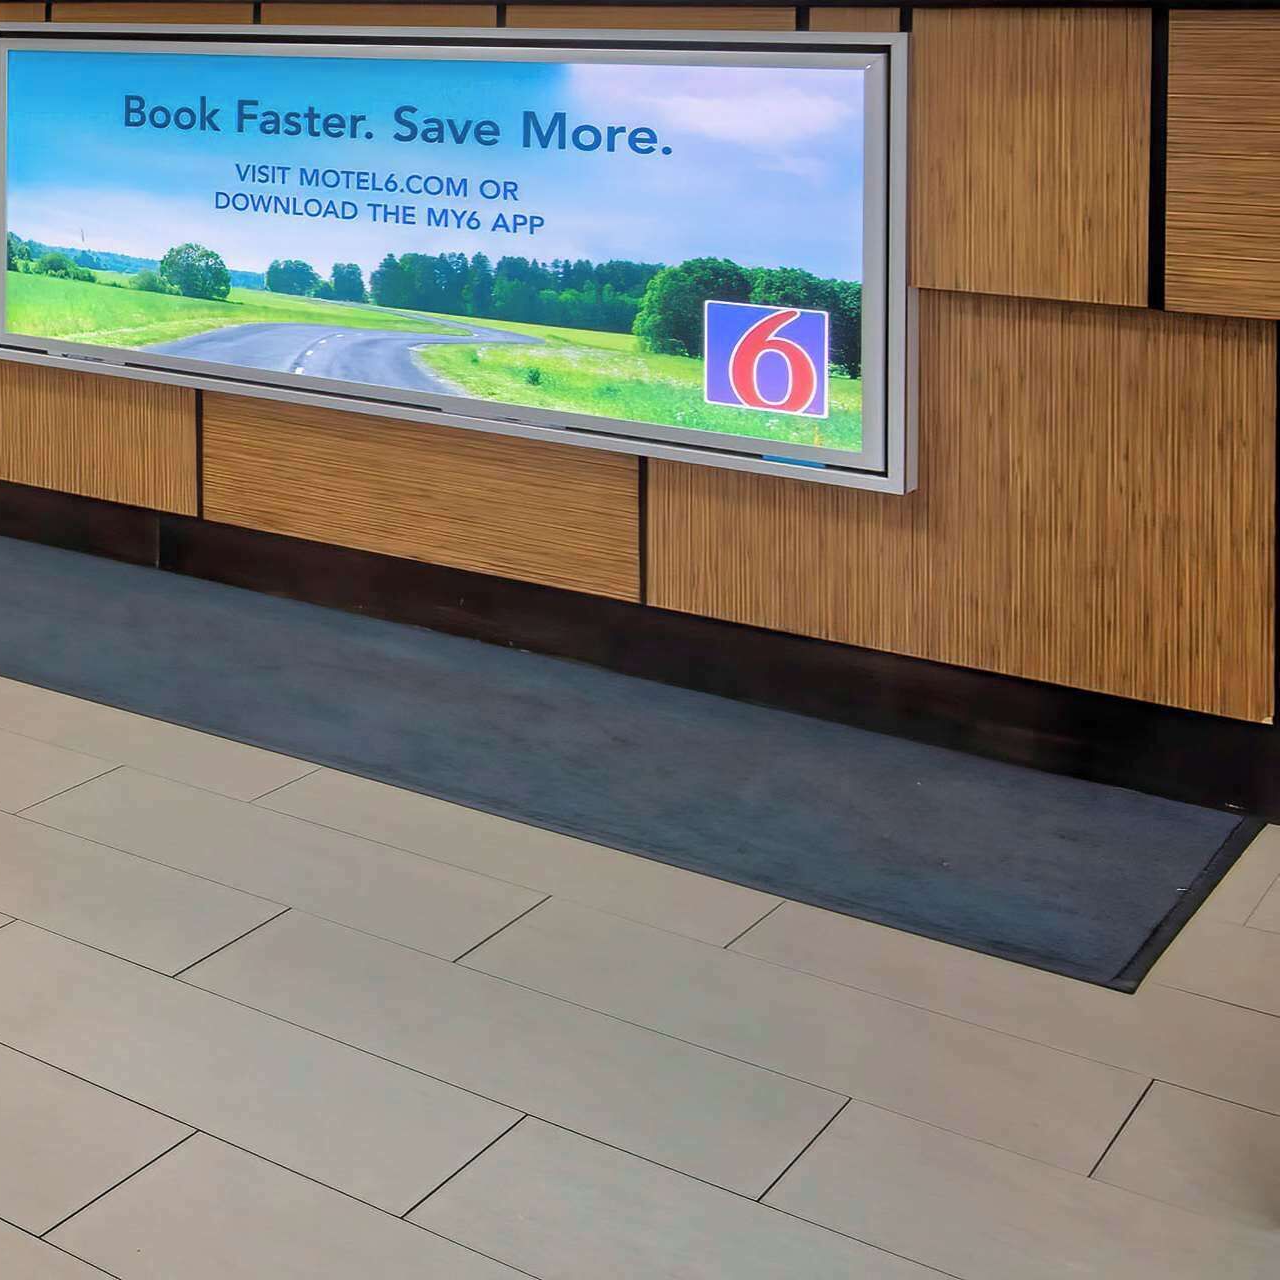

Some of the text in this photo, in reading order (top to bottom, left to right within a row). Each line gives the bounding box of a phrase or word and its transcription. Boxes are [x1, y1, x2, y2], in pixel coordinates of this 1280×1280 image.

[124, 94, 674, 156] Book Faster. Save More.
[235, 162, 519, 202] VISIT MOTEL6.COM OR
[214, 191, 545, 236] DOWNLOAD THE MY6 APP
[729, 309, 818, 415] 6
